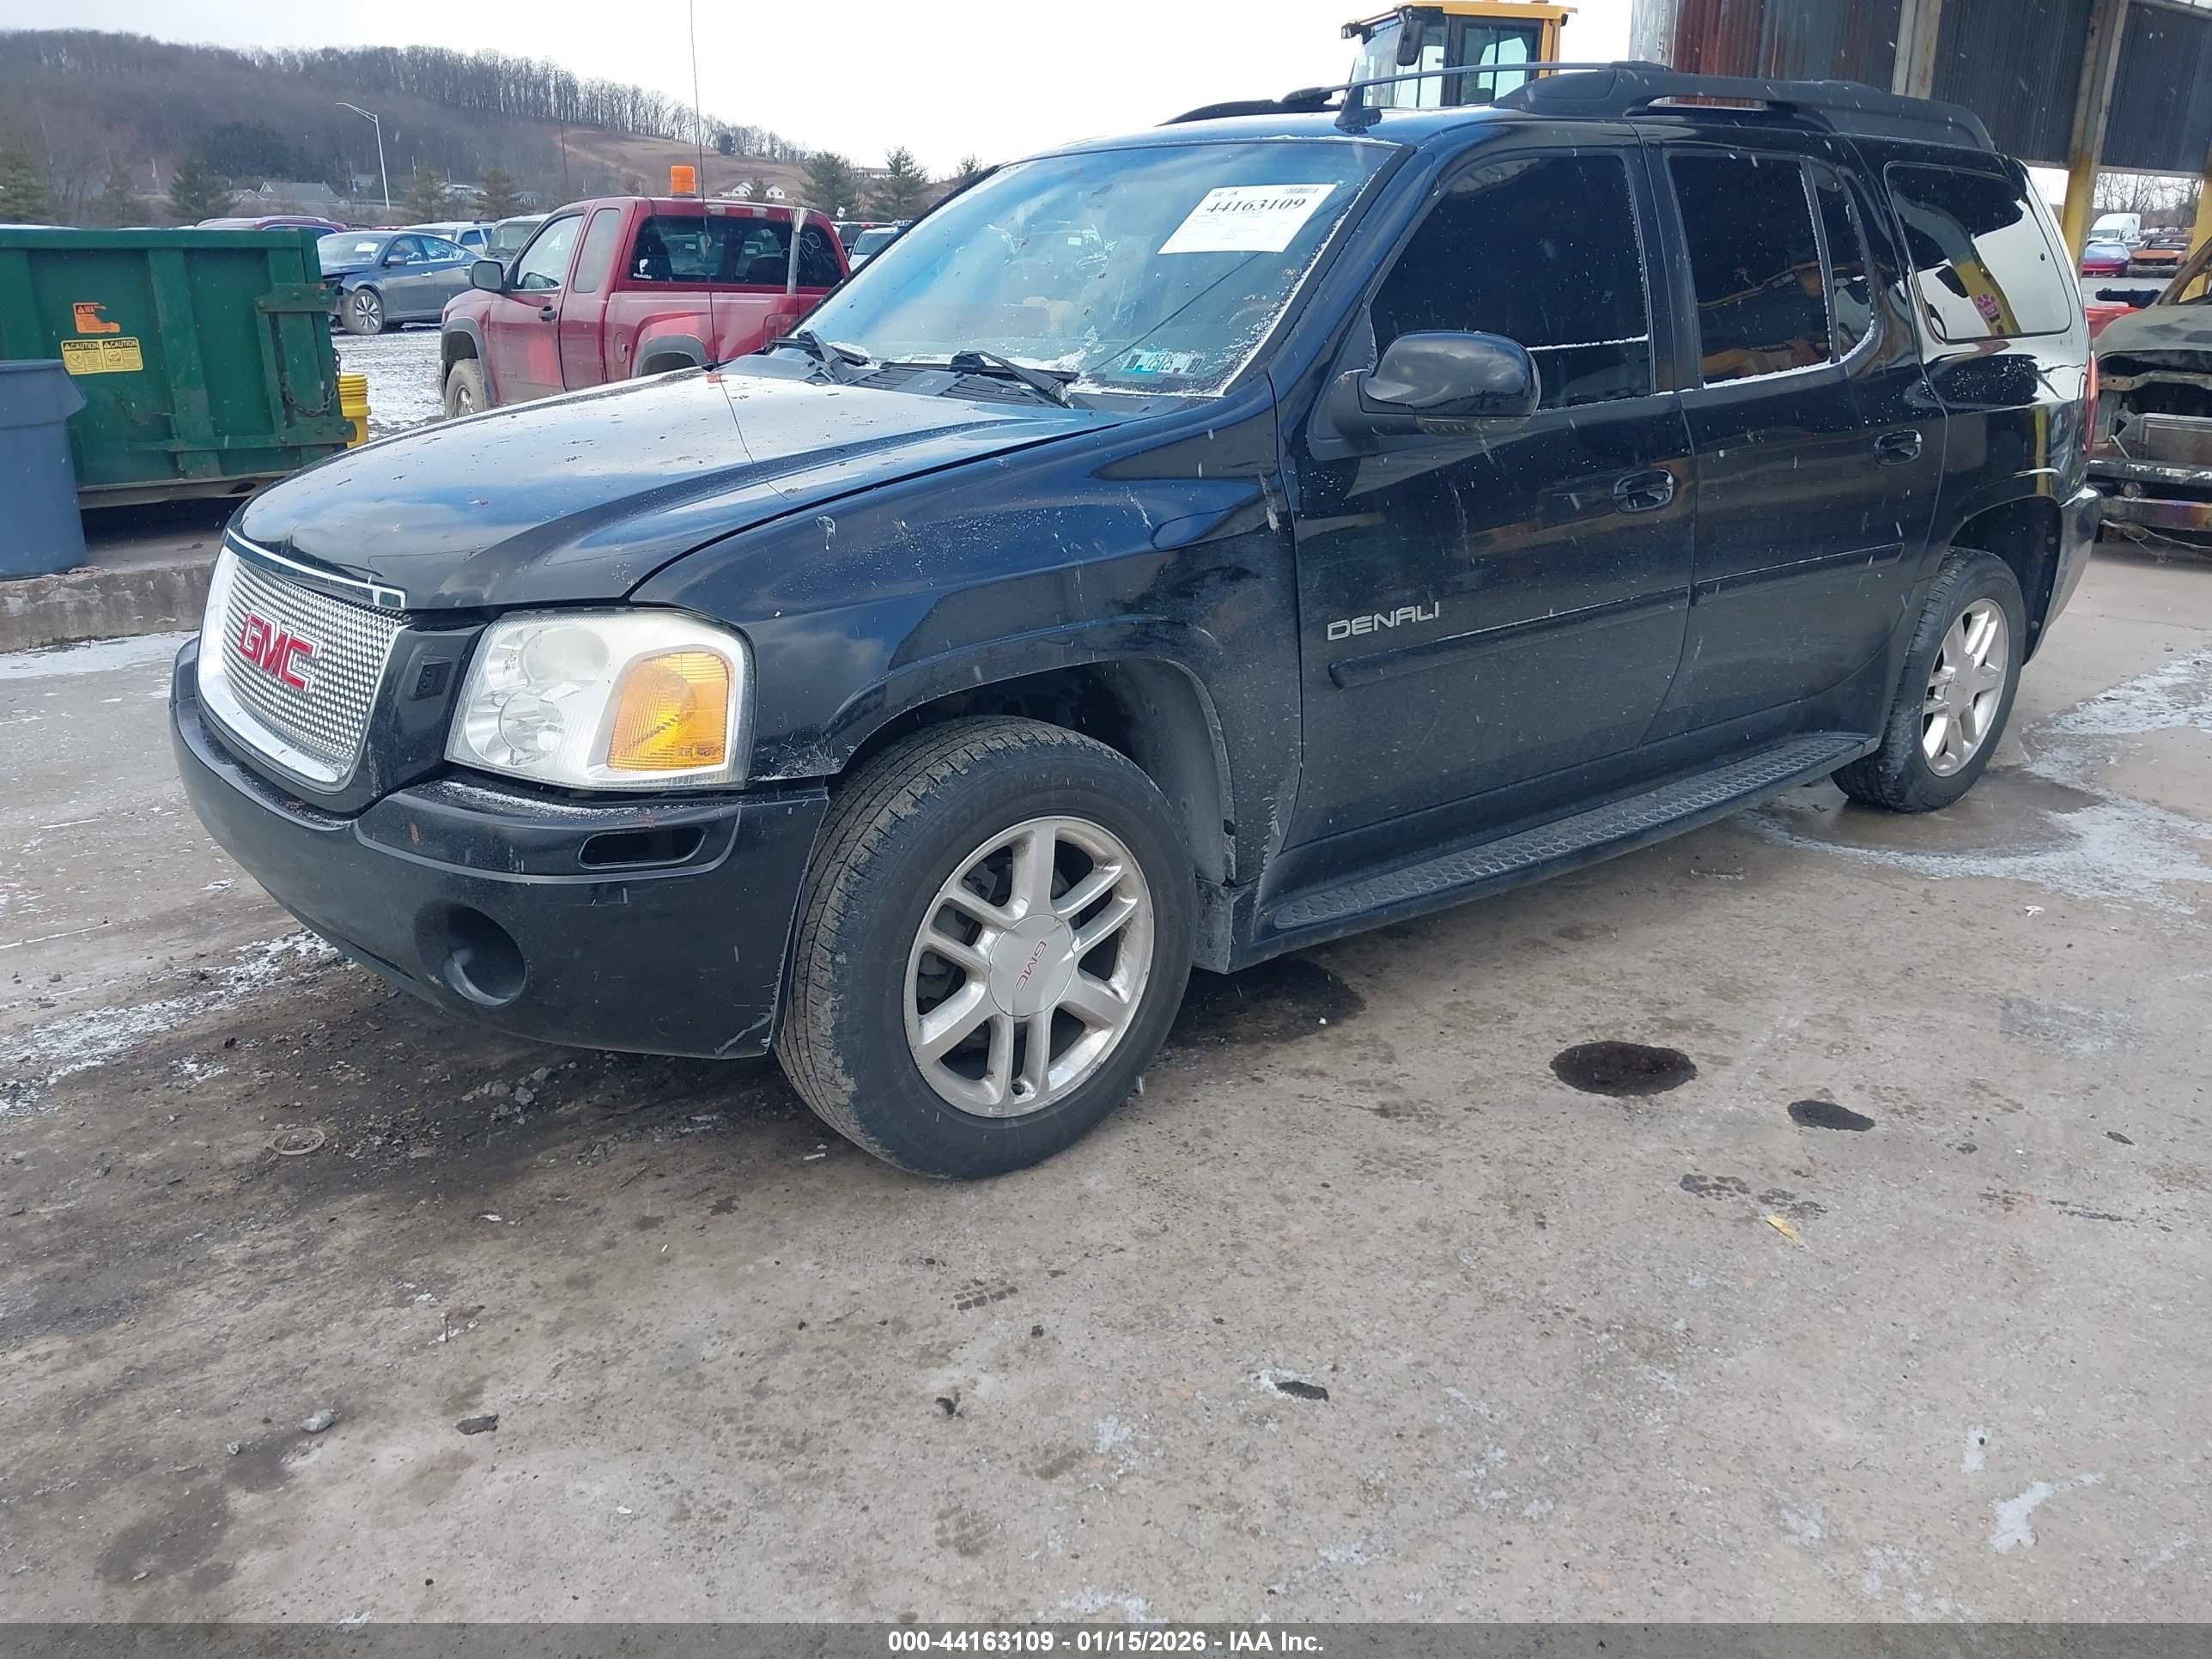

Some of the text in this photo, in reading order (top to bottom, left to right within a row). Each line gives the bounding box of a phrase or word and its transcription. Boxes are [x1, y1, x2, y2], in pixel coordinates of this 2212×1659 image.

[1206, 198, 1306, 214] 44163109
[110, 340, 138, 349] CAUTION
[1327, 601, 1439, 641] DENALI
[240, 610, 321, 693] GMC
[1015, 940, 1047, 991] GMC
